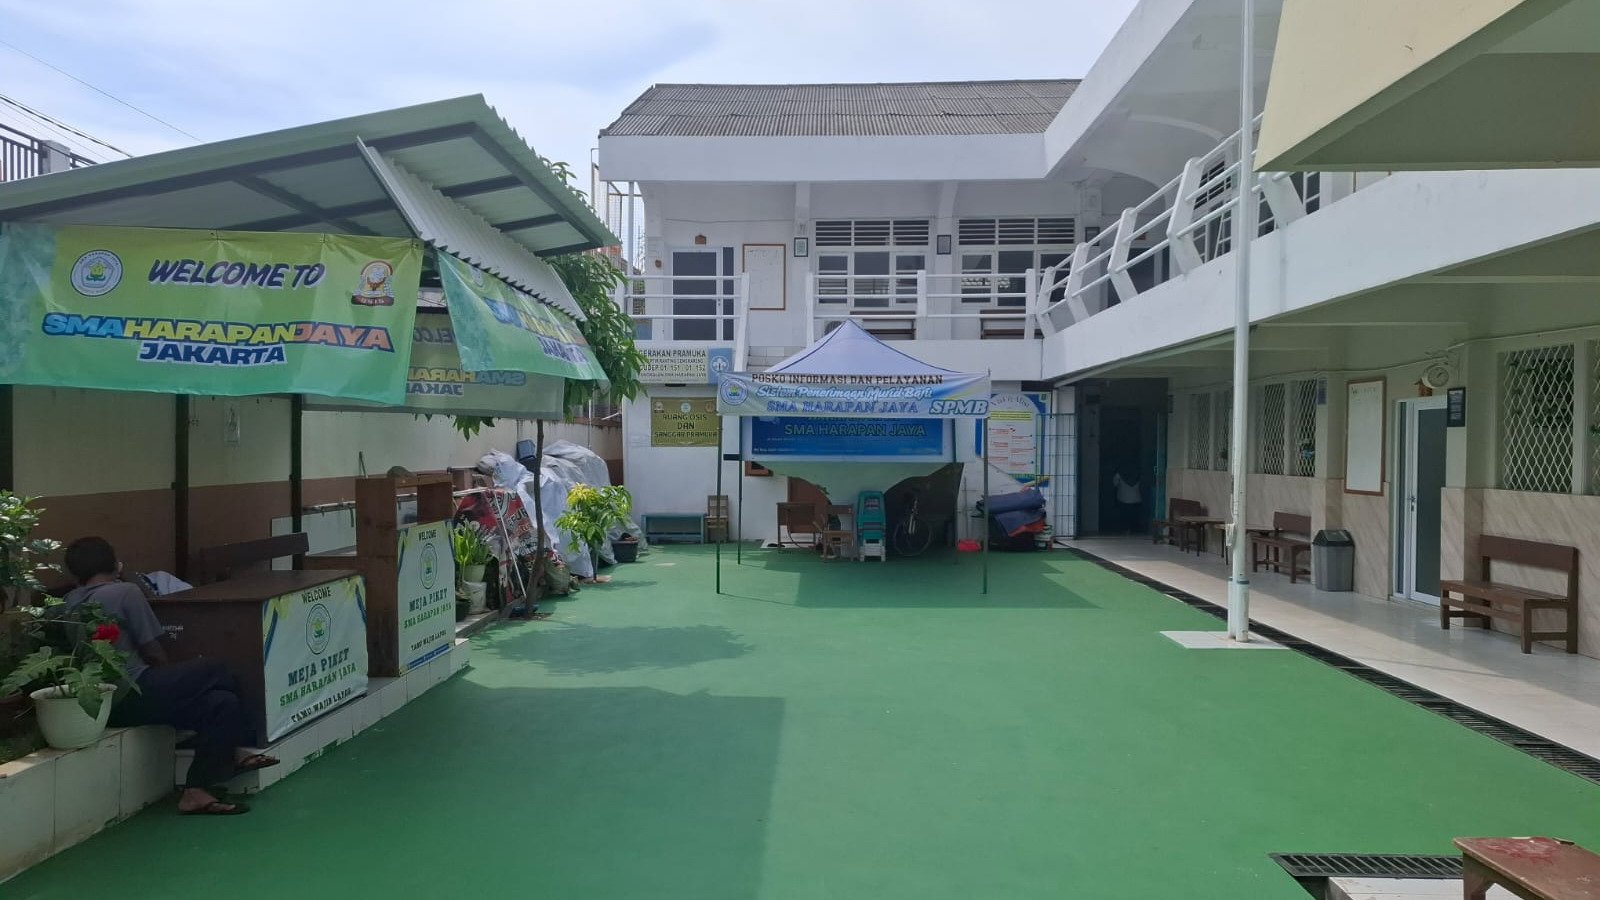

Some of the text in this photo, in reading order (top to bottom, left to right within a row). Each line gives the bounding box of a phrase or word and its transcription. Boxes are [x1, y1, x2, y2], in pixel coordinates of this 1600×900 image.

[148, 258, 286, 288] WELCOME
[293, 262, 325, 288] TO
[137, 341, 287, 365] JAKARTA
[673, 349, 706, 358] PRAMUKA
[751, 373, 943, 385] POSKO INFORMASI DAN PELAYANAN
[756, 385, 796, 398] Sistem
[767, 400, 919, 413] SMA HARAPAN JAYA
[928, 399, 989, 416] SPMB
[662, 413, 707, 421] RUANG OSIS
[677, 421, 695, 430] DAN
[783, 424, 928, 437] SMA HARAPAN JAYA
[301, 586, 332, 604] WELCOME
[408, 597, 427, 612] MEJA
[287, 647, 350, 687] MEJA PIKET
[279, 689, 299, 707] SMA
[300, 671, 338, 698] HARAPAN
[291, 707, 312, 722] TAMU
